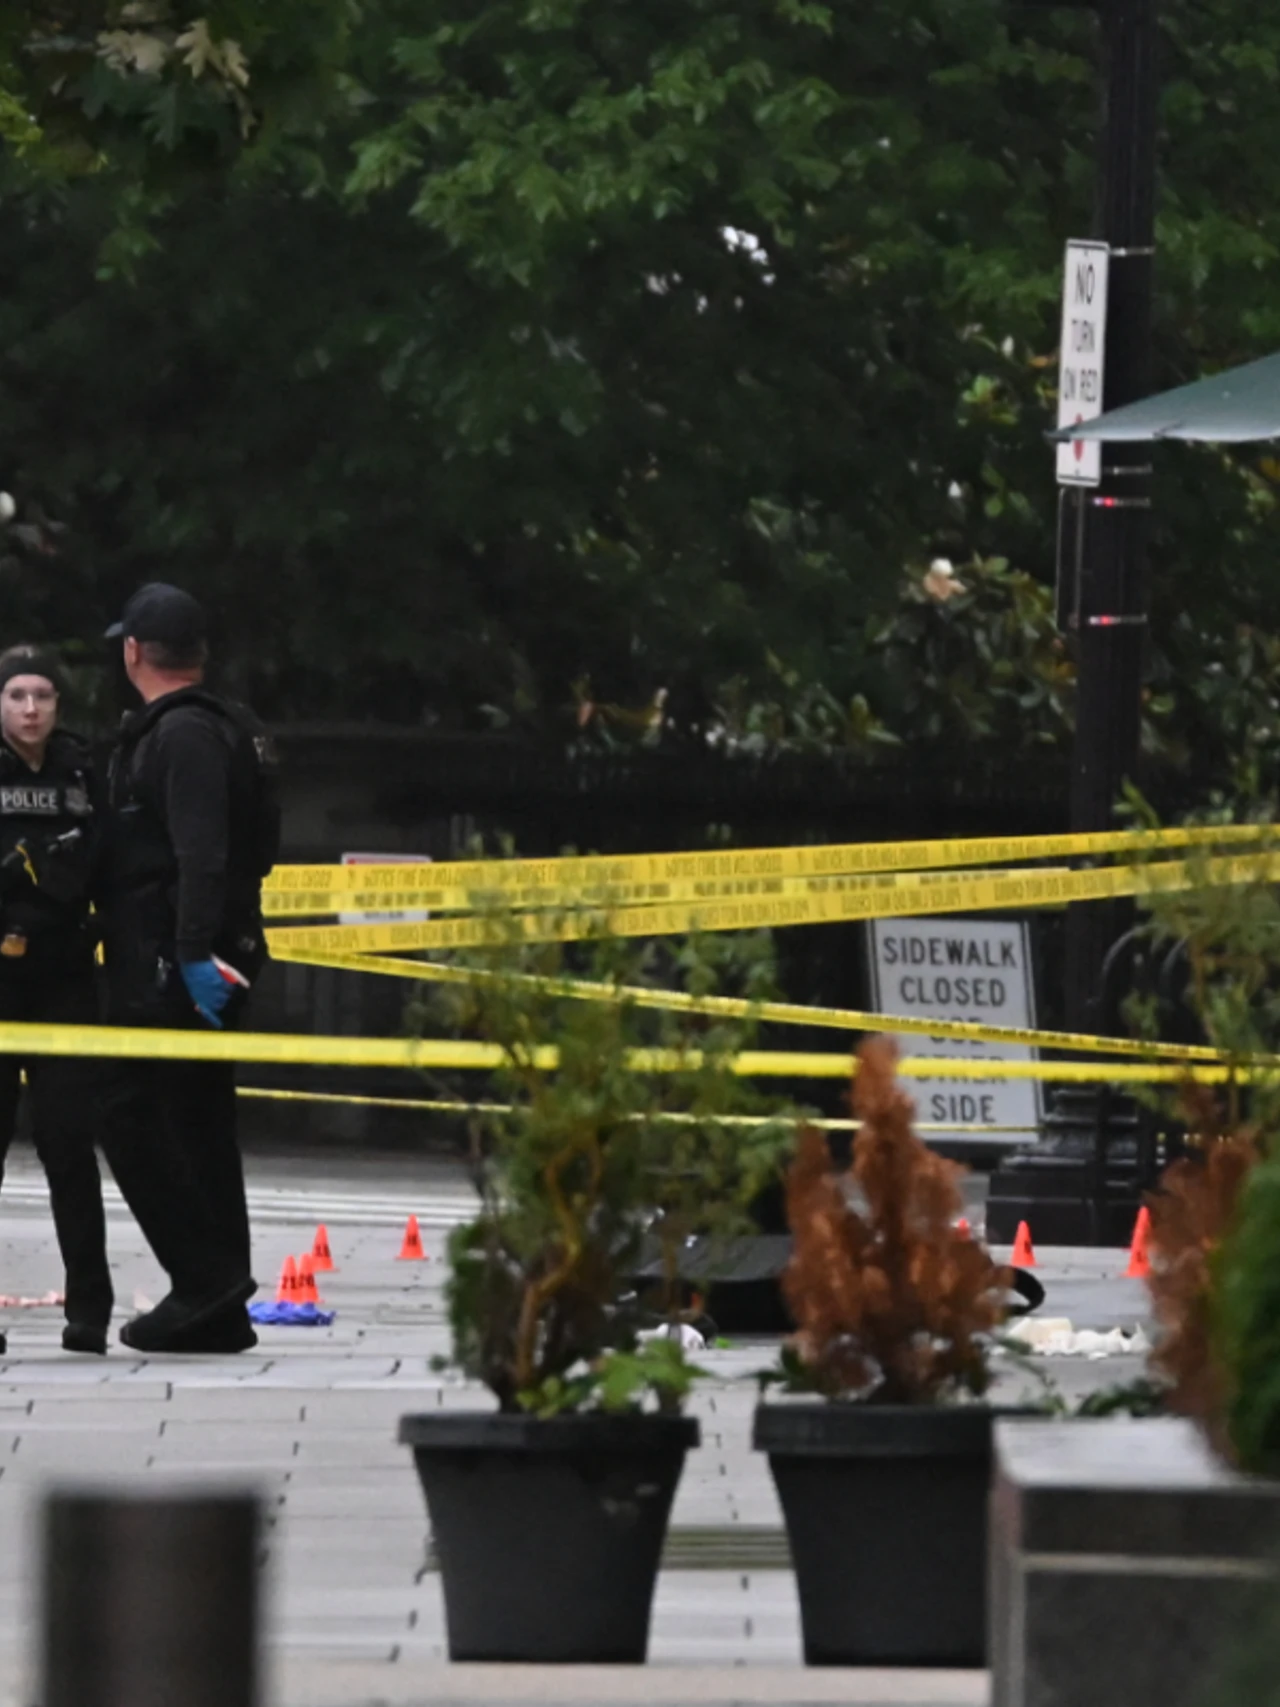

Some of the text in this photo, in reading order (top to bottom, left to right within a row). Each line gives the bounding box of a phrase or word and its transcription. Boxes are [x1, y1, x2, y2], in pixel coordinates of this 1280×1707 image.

[1075, 262, 1095, 305] NO
[1064, 366, 1076, 400] ON
[0, 789, 58, 810] POLICE
[883, 937, 1017, 968] SIDEWALK
[899, 976, 1007, 1008] CLOSED
[931, 1094, 996, 1123] SIDE
